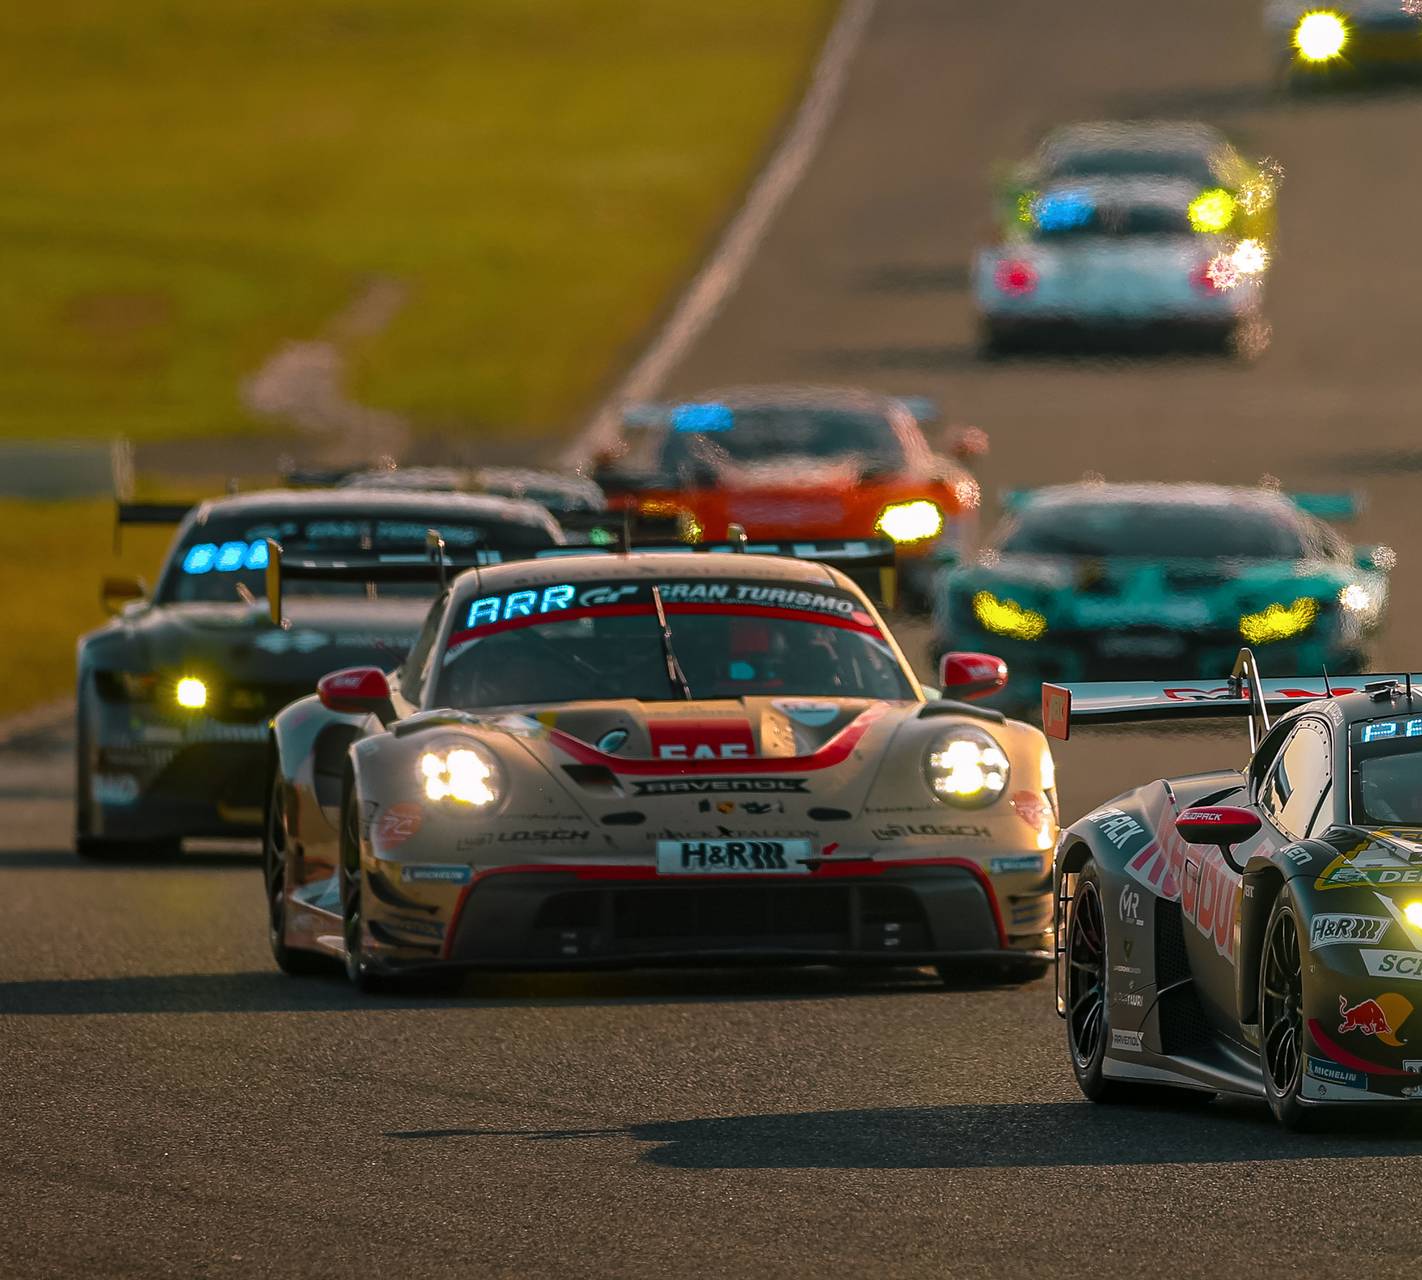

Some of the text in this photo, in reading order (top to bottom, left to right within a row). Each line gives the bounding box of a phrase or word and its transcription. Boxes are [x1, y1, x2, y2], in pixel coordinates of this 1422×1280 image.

[467, 584, 575, 628] ARR
[657, 584, 728, 598] GRAN
[735, 585, 855, 614] TURISMO
[646, 780, 795, 792] RAVENOL
[497, 830, 590, 842] LOSCH
[906, 824, 992, 838] LOSCH
[681, 841, 749, 868] H&R
[1312, 919, 1351, 943] H&R
[1313, 1066, 1358, 1082] MICHELIN
